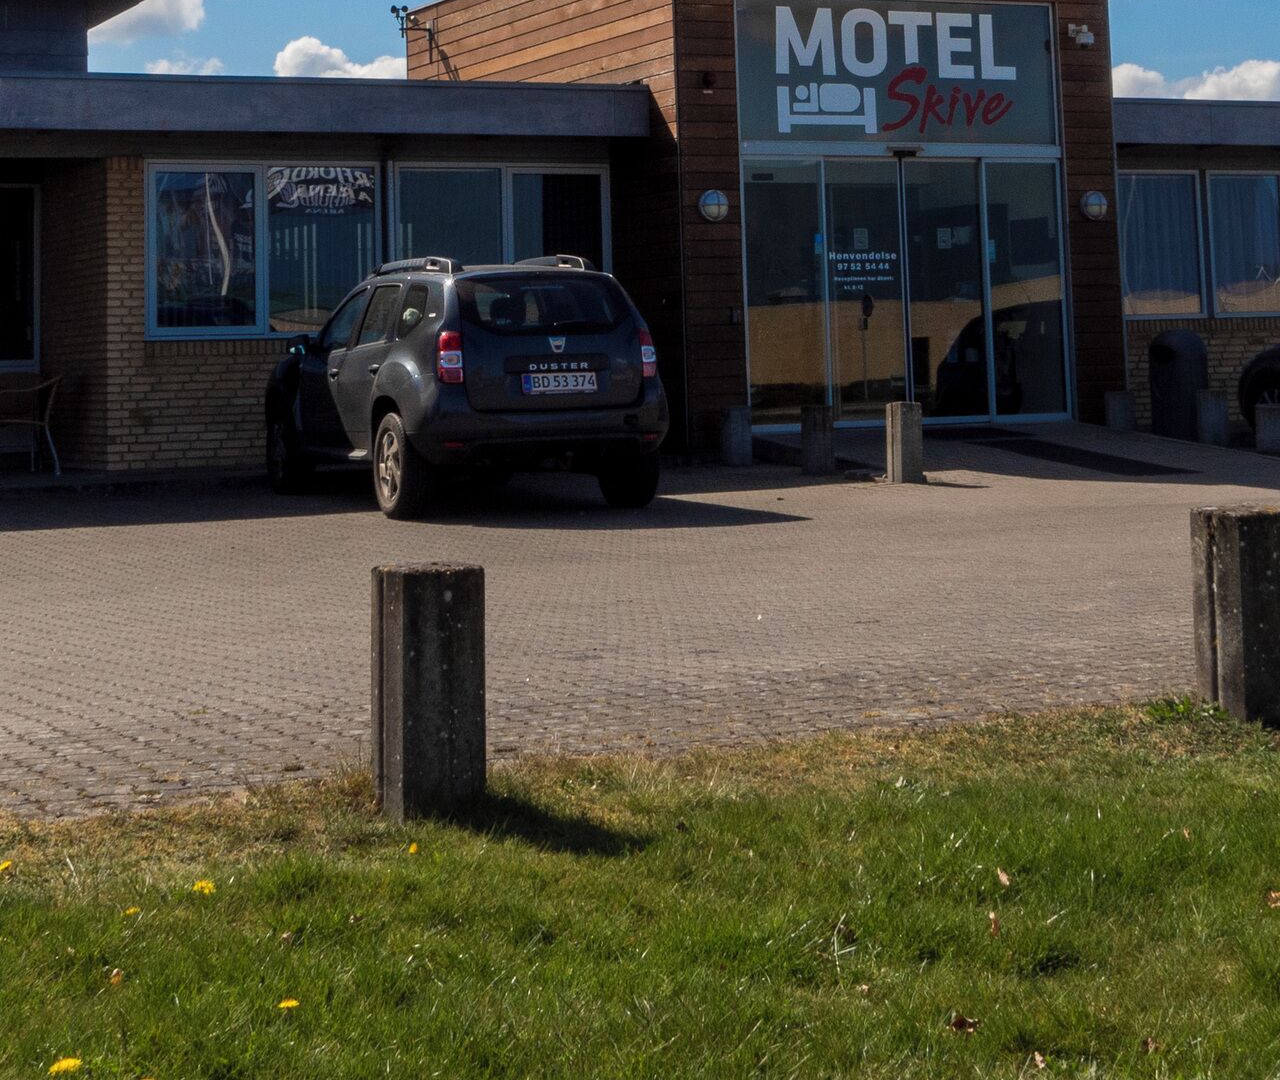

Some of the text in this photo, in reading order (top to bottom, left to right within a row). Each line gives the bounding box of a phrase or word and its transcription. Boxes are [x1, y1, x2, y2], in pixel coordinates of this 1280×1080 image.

[775, 5, 1017, 81] MOTEL
[882, 66, 1014, 134] Skive
[829, 251, 897, 260] Henvendelse
[529, 362, 589, 371] DUSTER
[532, 374, 595, 389] BD 53 374
